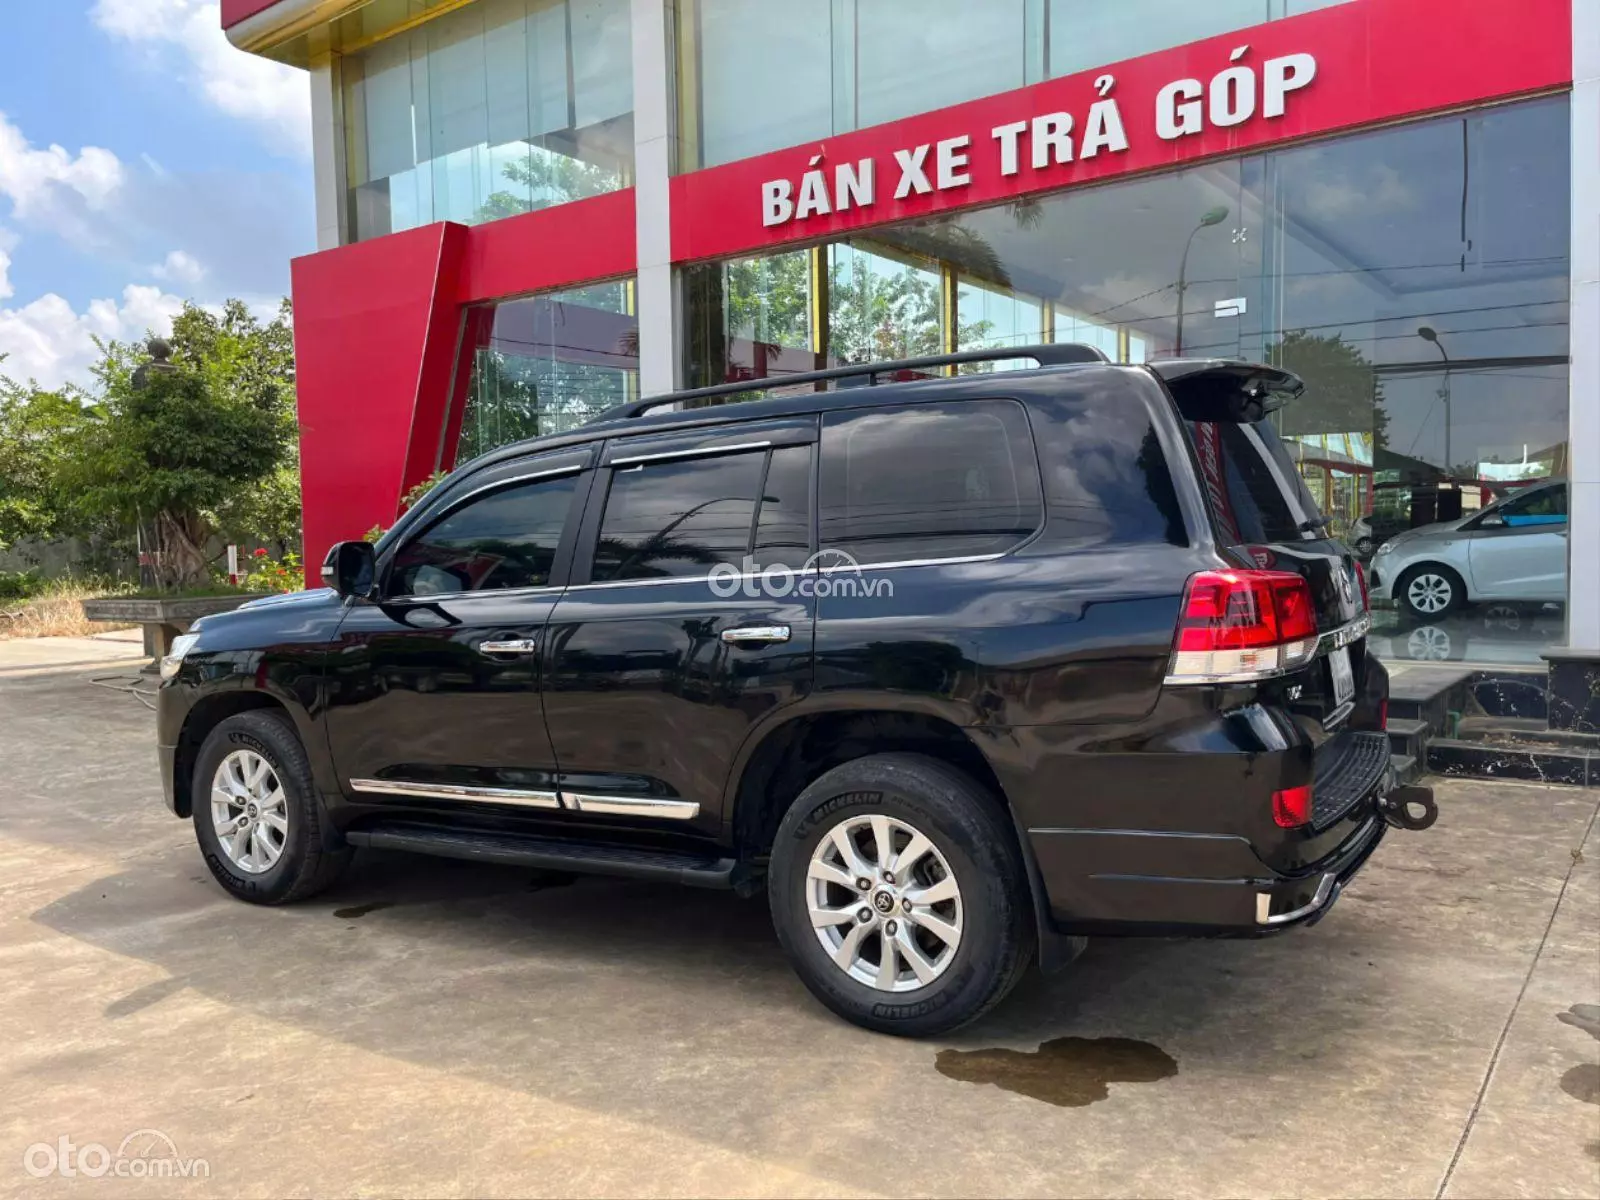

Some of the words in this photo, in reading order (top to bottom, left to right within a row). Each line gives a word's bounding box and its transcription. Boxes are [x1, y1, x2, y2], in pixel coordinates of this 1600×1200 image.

[761, 158, 875, 227] BÁN
[893, 135, 972, 199] XE
[991, 74, 1130, 176] TRẢ
[1155, 45, 1318, 141] GÓP
[812, 792, 881, 823] MICHELIN
